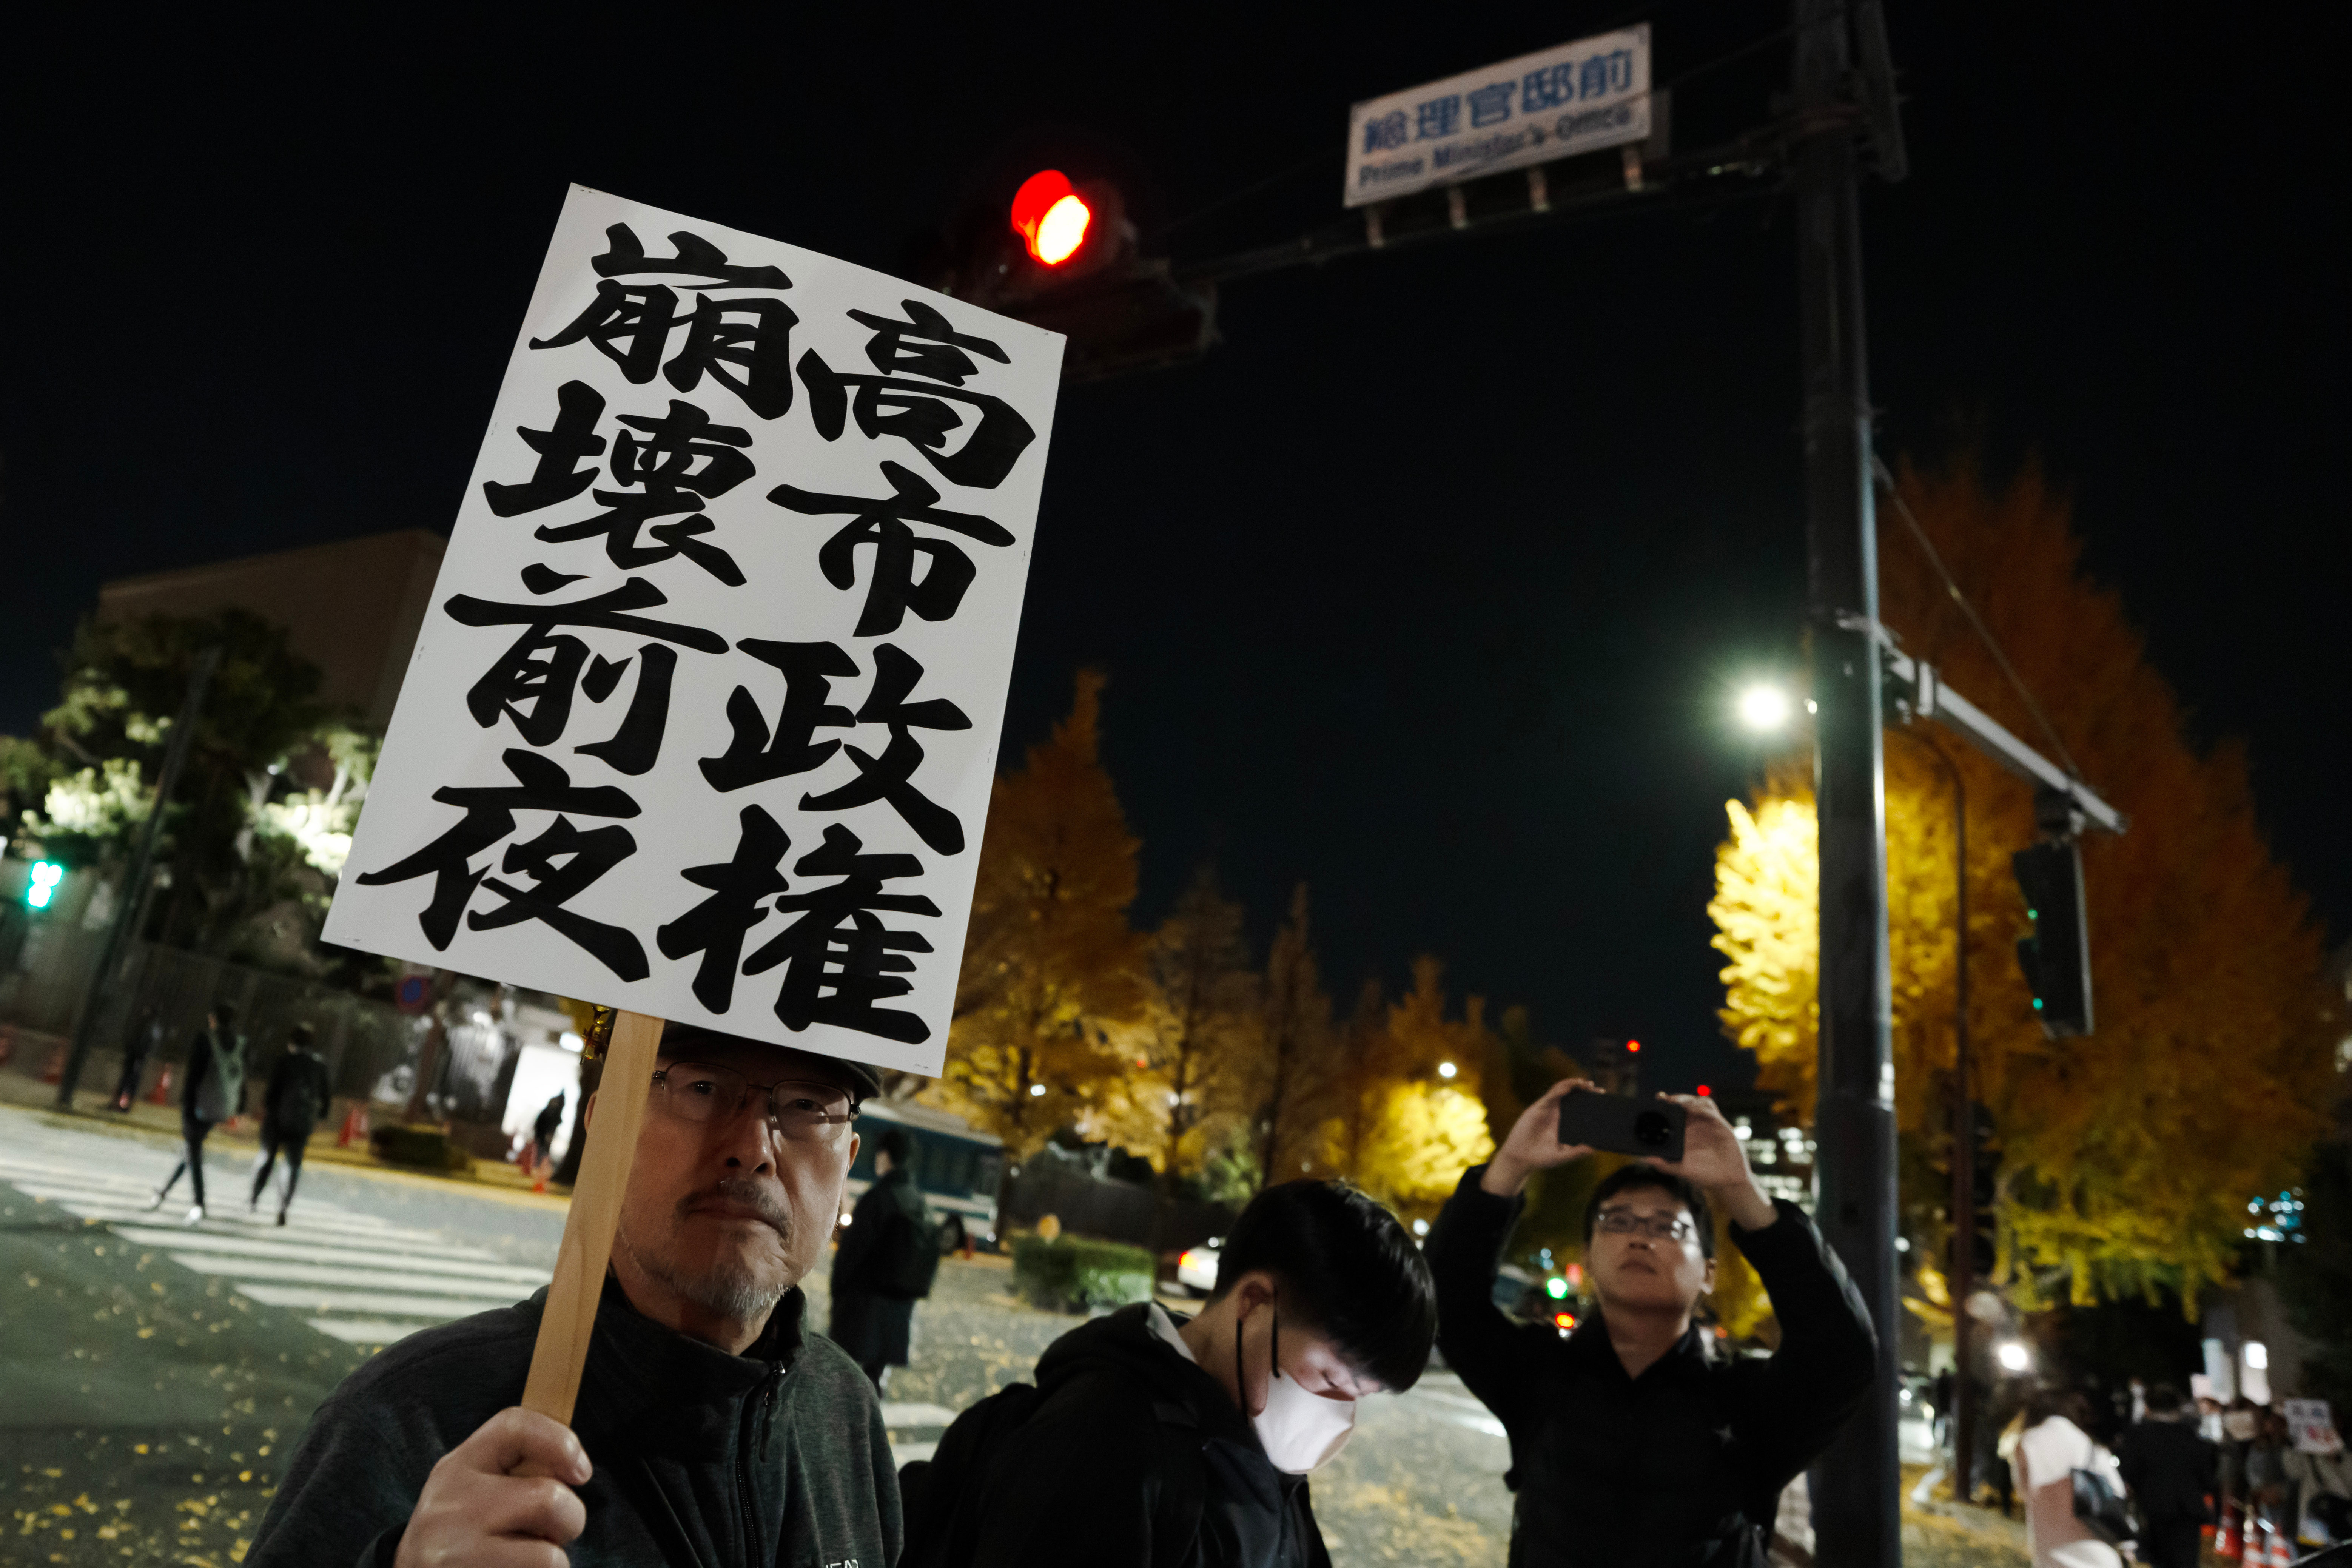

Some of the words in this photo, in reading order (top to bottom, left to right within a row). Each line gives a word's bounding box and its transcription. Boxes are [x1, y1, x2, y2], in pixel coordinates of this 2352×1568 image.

[1360, 159, 1422, 184] Prime
[1433, 125, 1544, 167] Minister's
[1556, 103, 1631, 140] Office
[1364, 50, 1632, 153] 総理官邸前
[356, 222, 799, 982] 崩壊前夜
[657, 299, 1036, 1044] 高市政権
